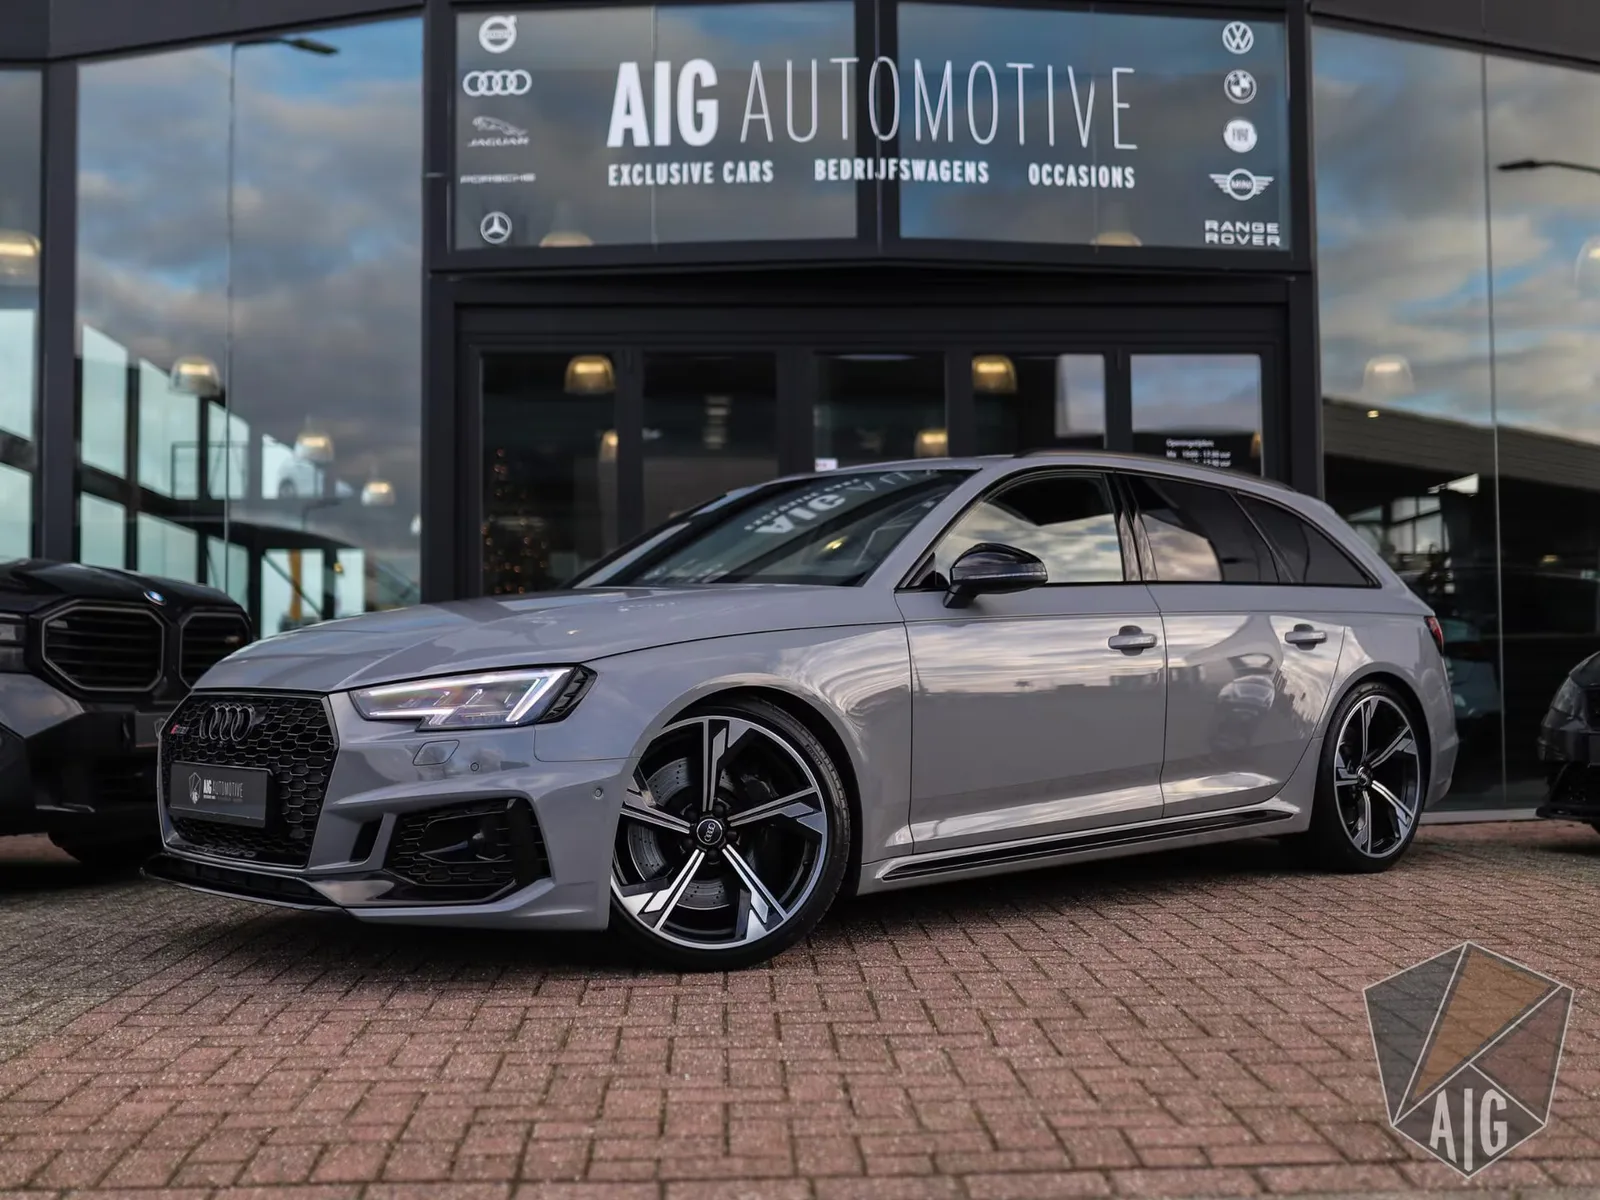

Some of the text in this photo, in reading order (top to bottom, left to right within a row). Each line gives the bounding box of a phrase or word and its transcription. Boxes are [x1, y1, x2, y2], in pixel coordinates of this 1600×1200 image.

[606, 56, 1138, 149] AIG AUTOMOTIVE
[608, 159, 774, 187] EXCLUSIVE CARS
[814, 158, 990, 184] BEDRIJFSWAGENS
[1028, 162, 1136, 189] OCCASIONS
[1204, 220, 1279, 234] RANGE
[1204, 232, 1281, 246] ROVER
